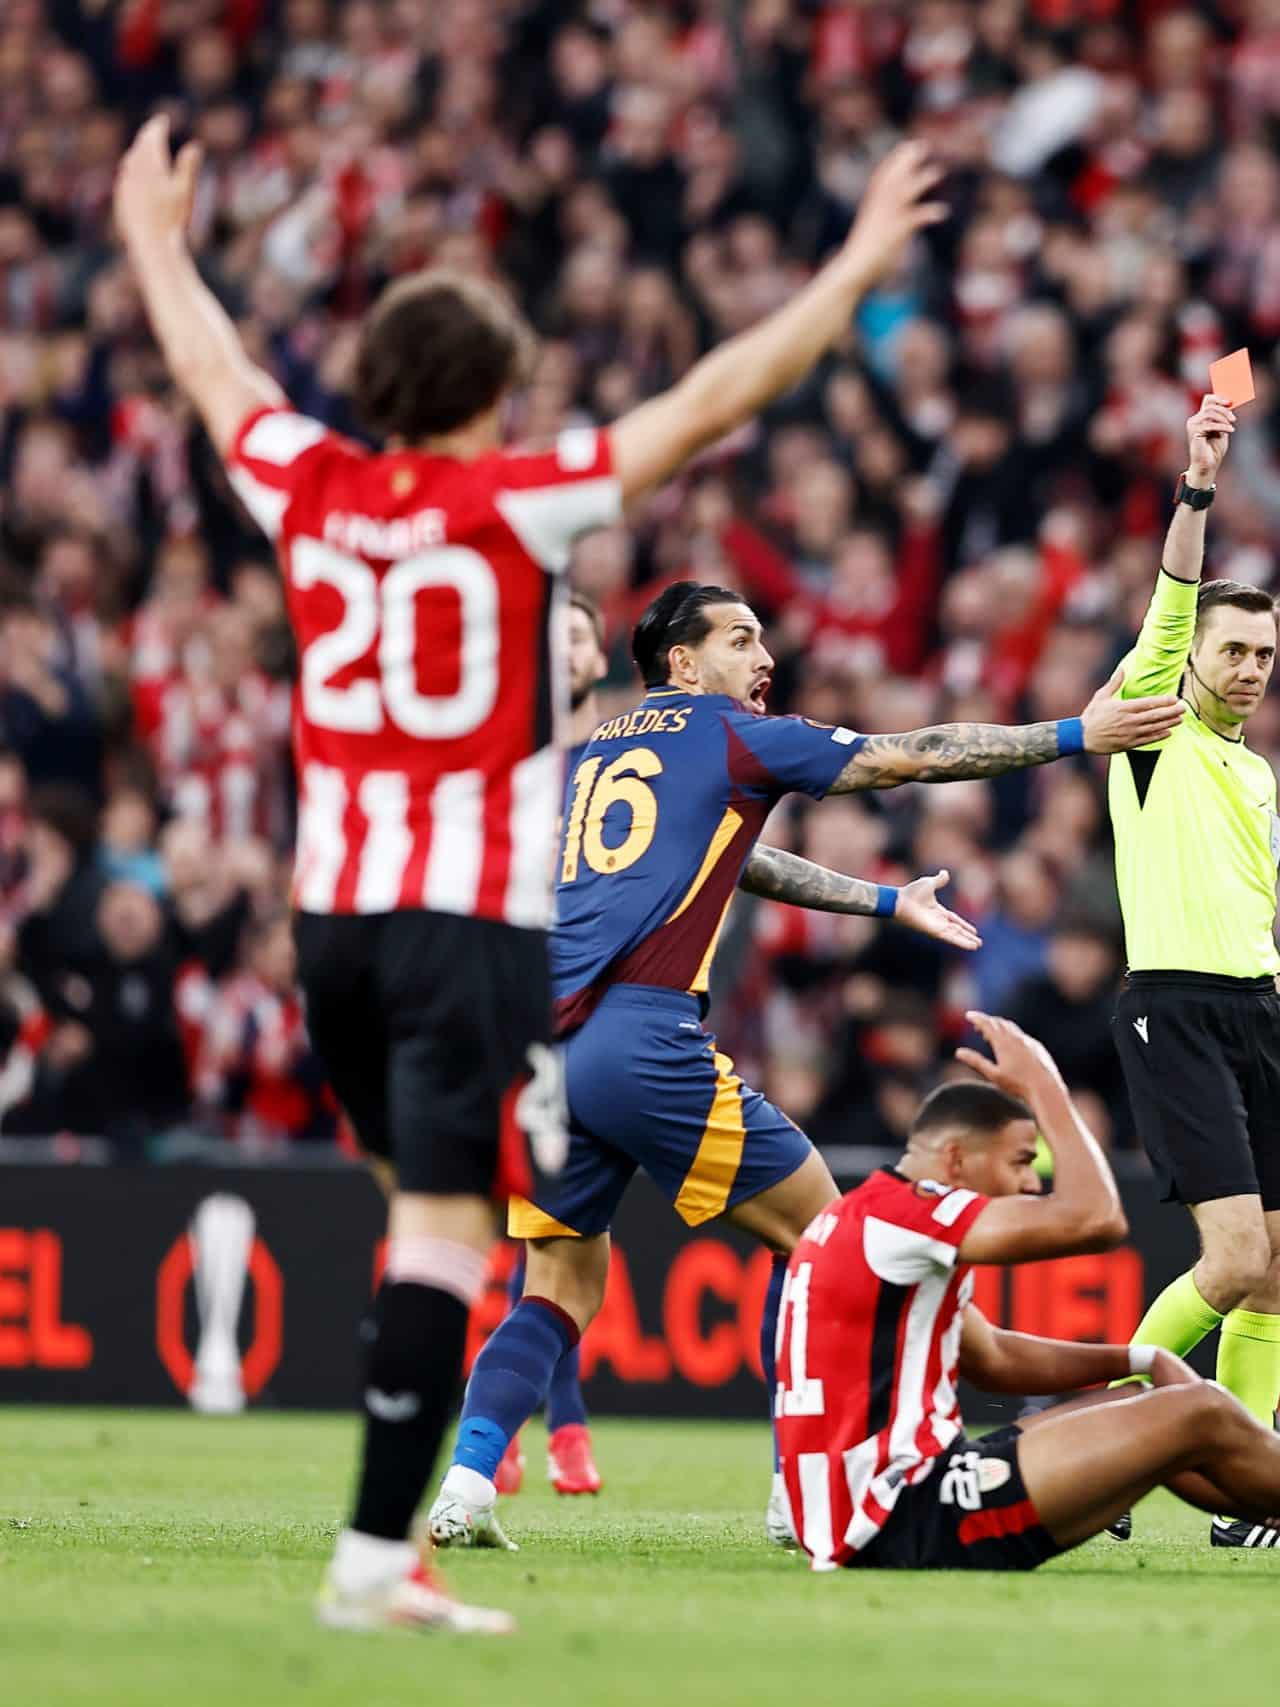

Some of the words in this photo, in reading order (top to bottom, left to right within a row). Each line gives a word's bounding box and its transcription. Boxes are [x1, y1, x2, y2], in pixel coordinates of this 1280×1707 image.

[290, 536, 501, 740] 20
[591, 707, 694, 742] AREDES
[560, 747, 664, 884] 16
